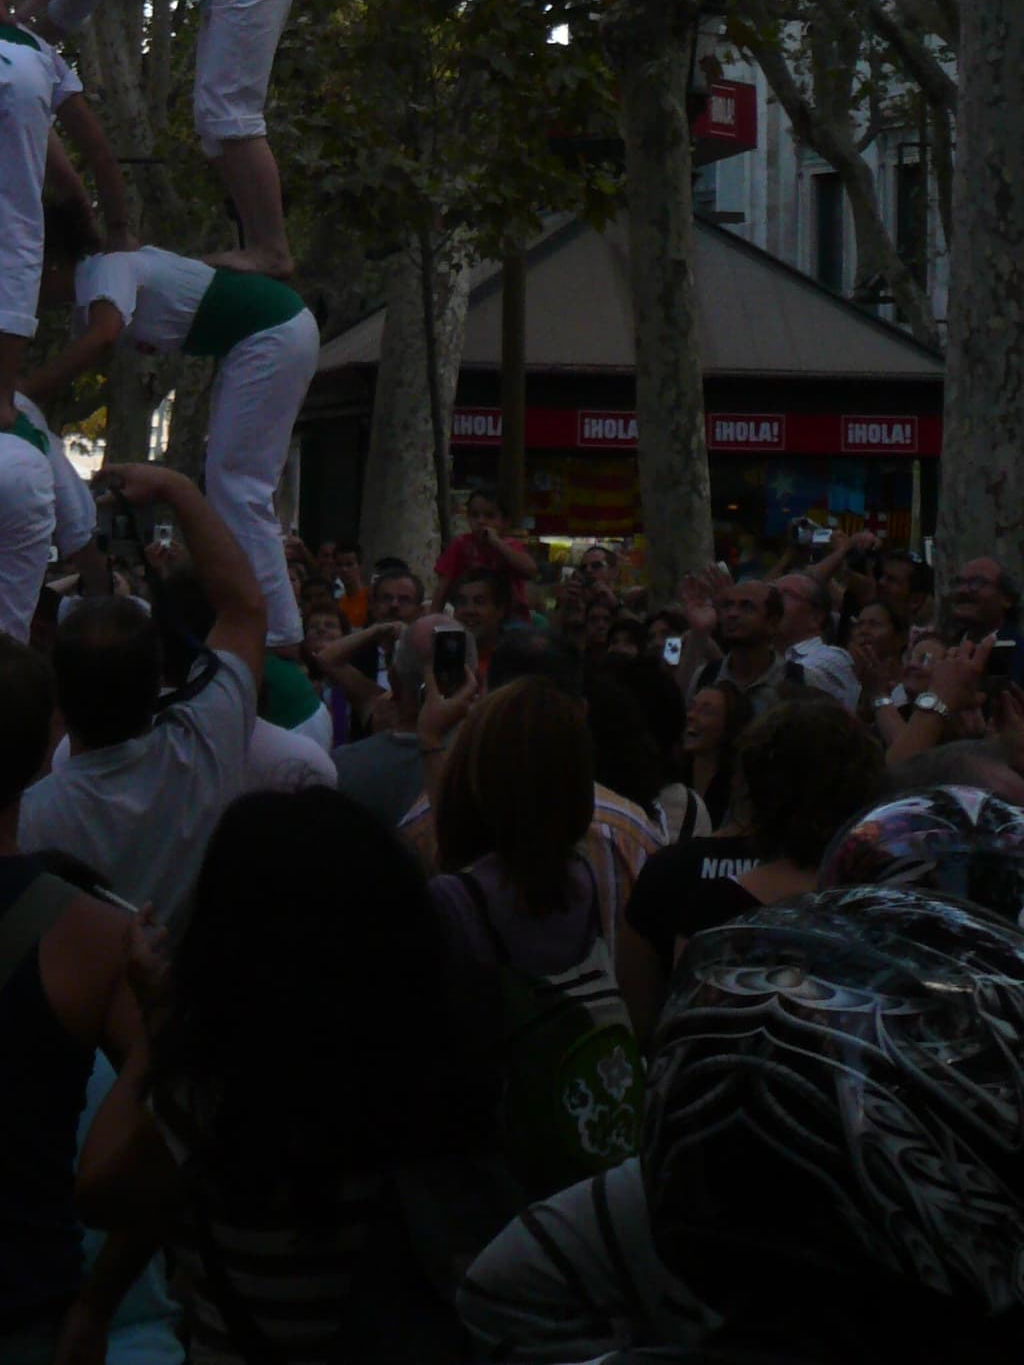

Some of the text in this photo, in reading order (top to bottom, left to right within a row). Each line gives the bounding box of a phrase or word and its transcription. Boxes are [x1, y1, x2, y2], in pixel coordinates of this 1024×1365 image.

[453, 413, 502, 436] ¡HOL
[585, 417, 639, 439] ¡HOLA
[715, 420, 779, 442] ¡HOLA!
[847, 423, 912, 444] ¡HOLA!
